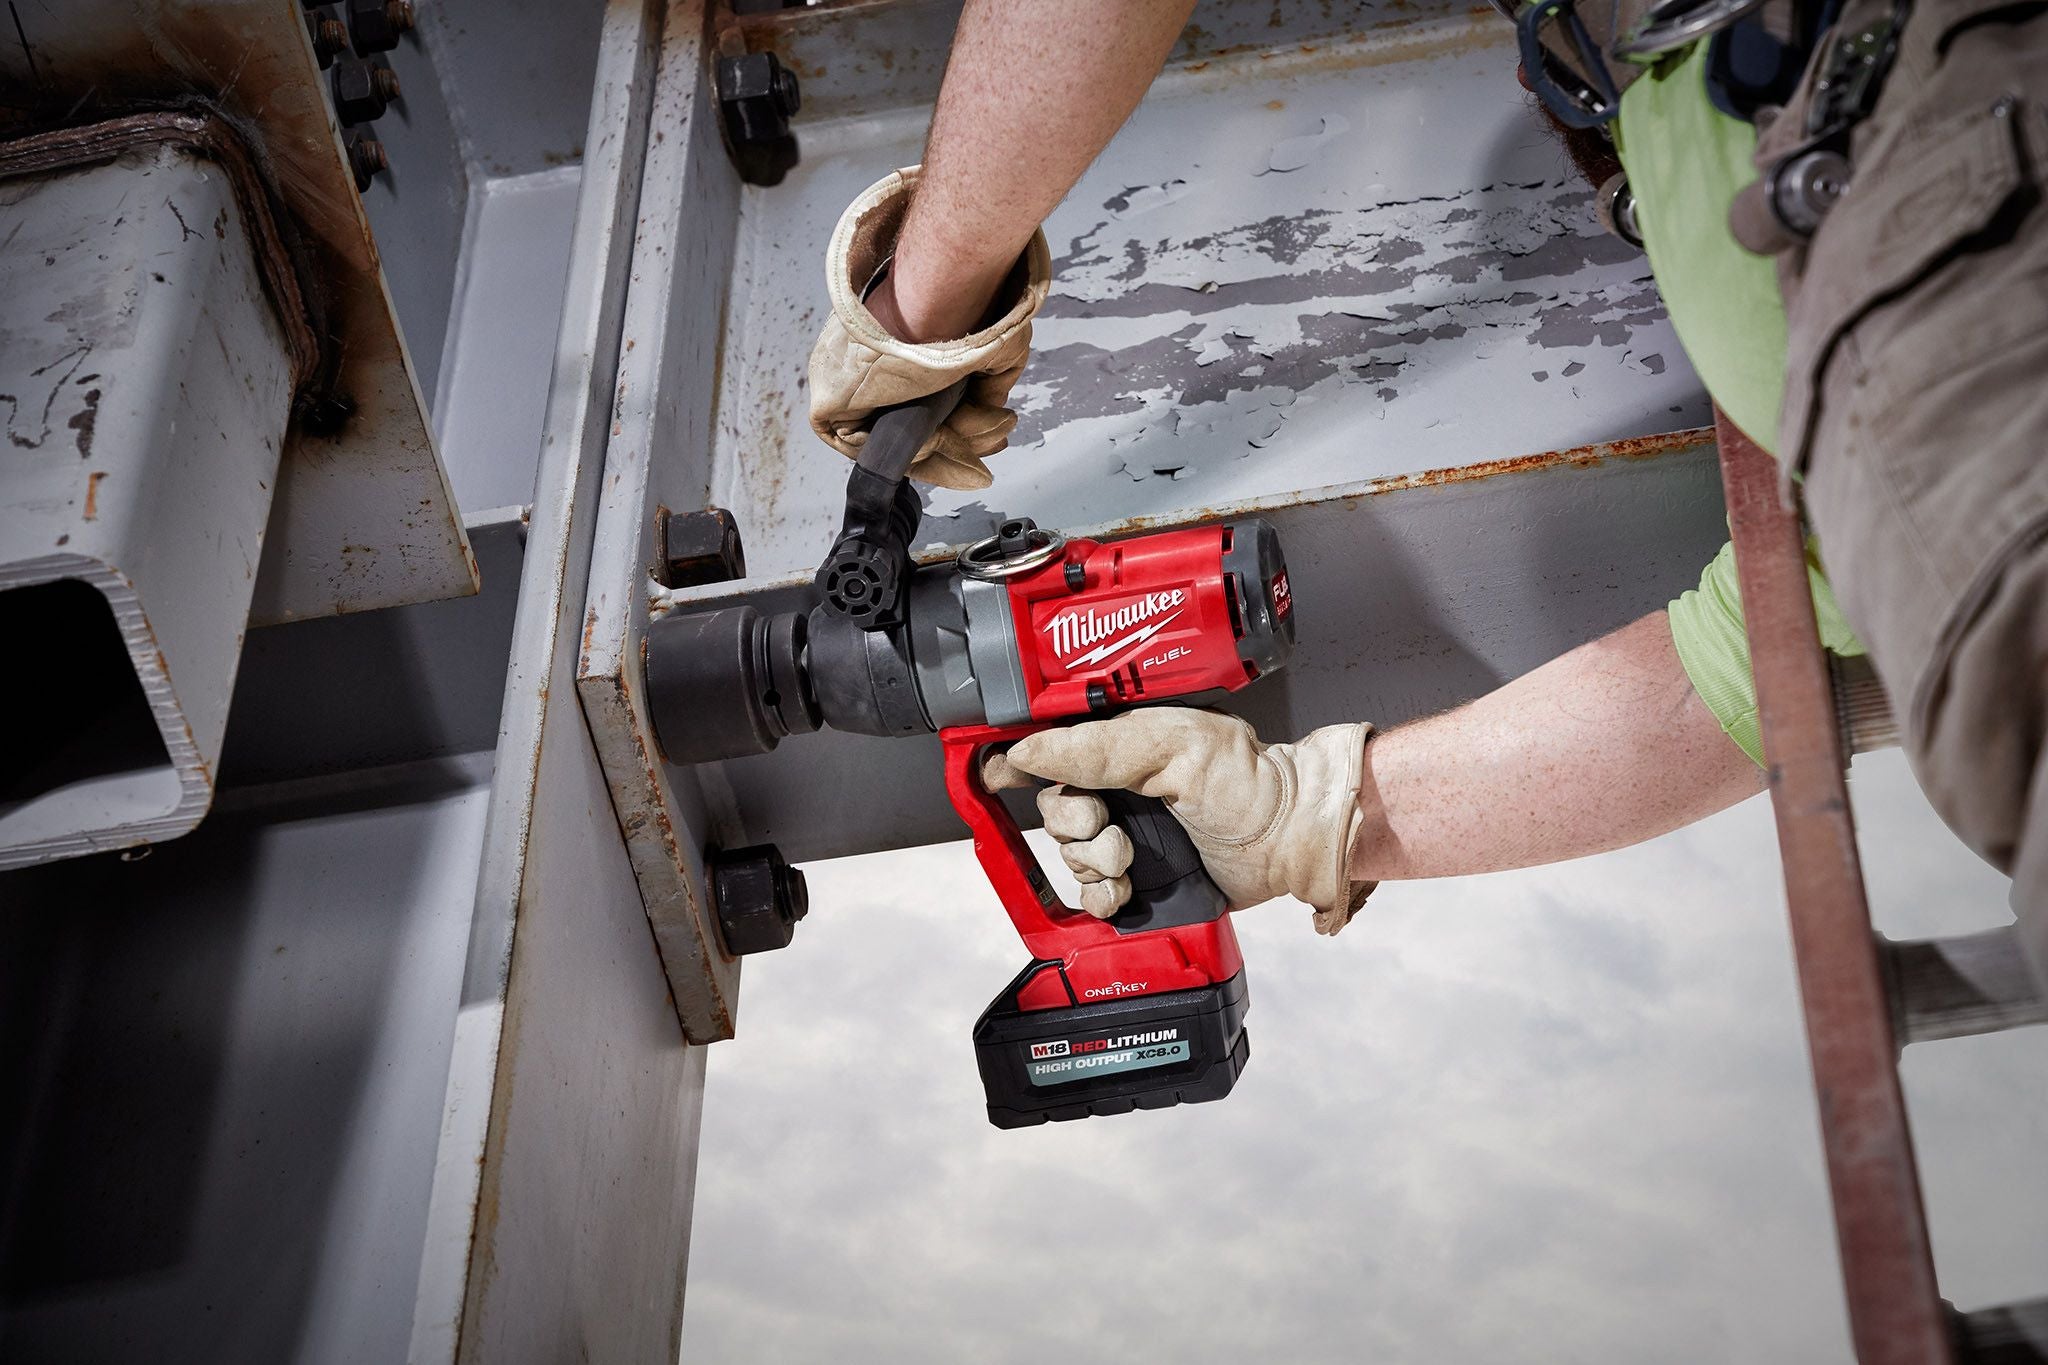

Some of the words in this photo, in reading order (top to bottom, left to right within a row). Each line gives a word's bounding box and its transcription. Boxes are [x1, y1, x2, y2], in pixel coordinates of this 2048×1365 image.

[1043, 588, 1186, 658] Milwaukee
[1143, 645, 1192, 670] FUEL
[1033, 1043, 1067, 1057] M18
[1035, 1061, 1072, 1075] HIGH
[1075, 1050, 1133, 1069] OUTPUT
[1136, 1045, 1181, 1061] XC8.0
